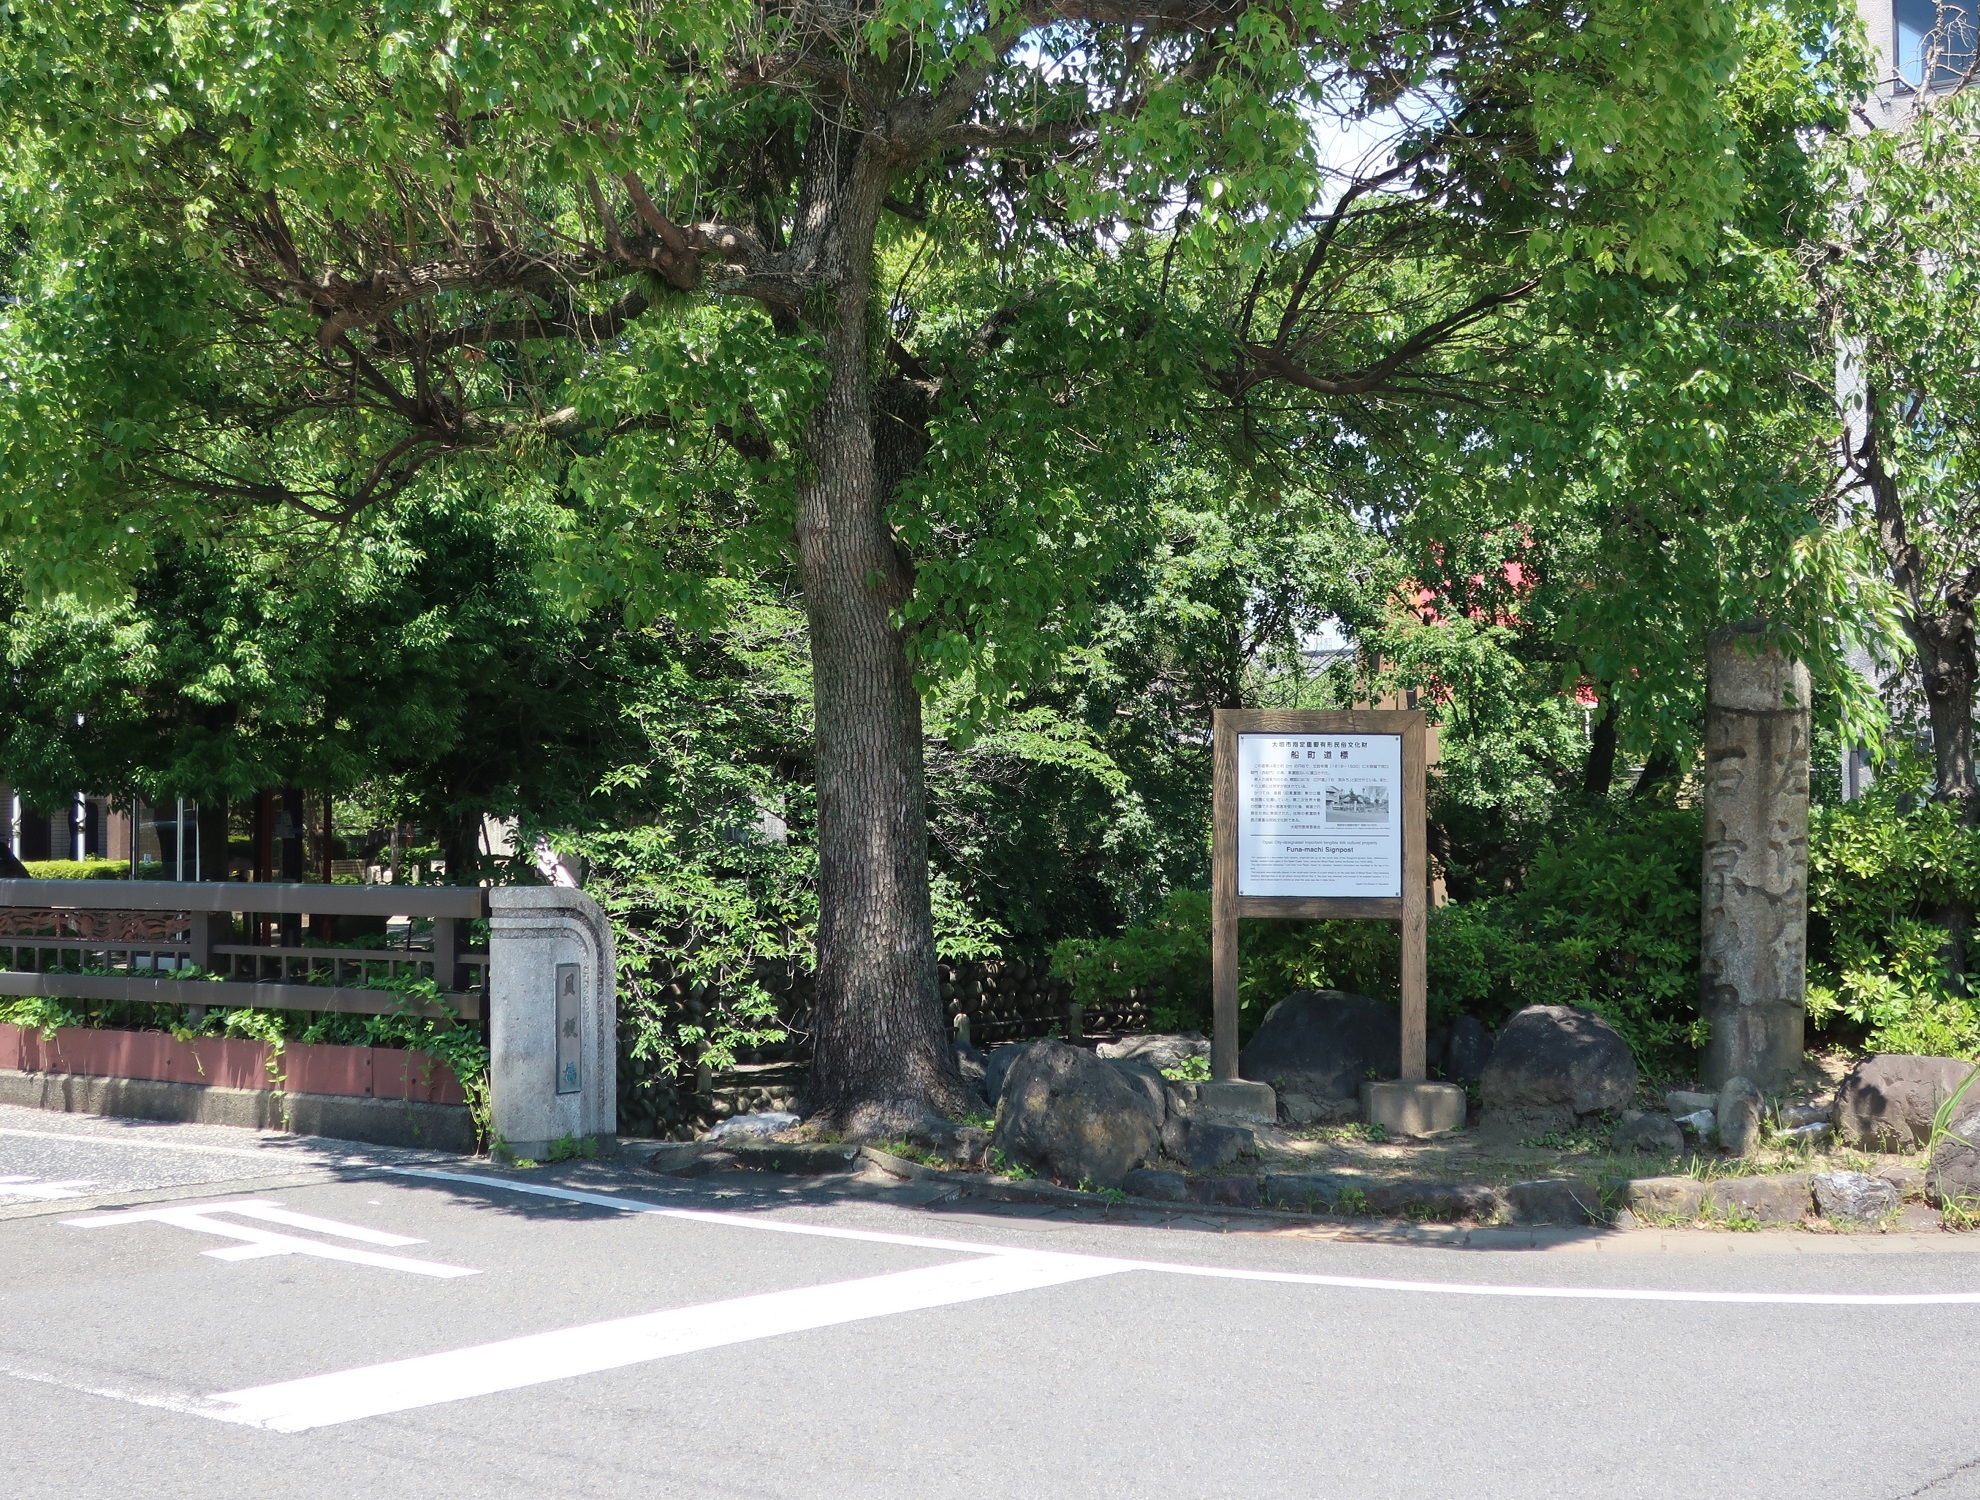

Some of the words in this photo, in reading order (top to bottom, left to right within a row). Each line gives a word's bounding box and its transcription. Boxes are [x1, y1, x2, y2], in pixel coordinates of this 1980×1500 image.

[1291, 750, 1349, 760] 船町道標
[1325, 846, 1354, 854] Signpost
